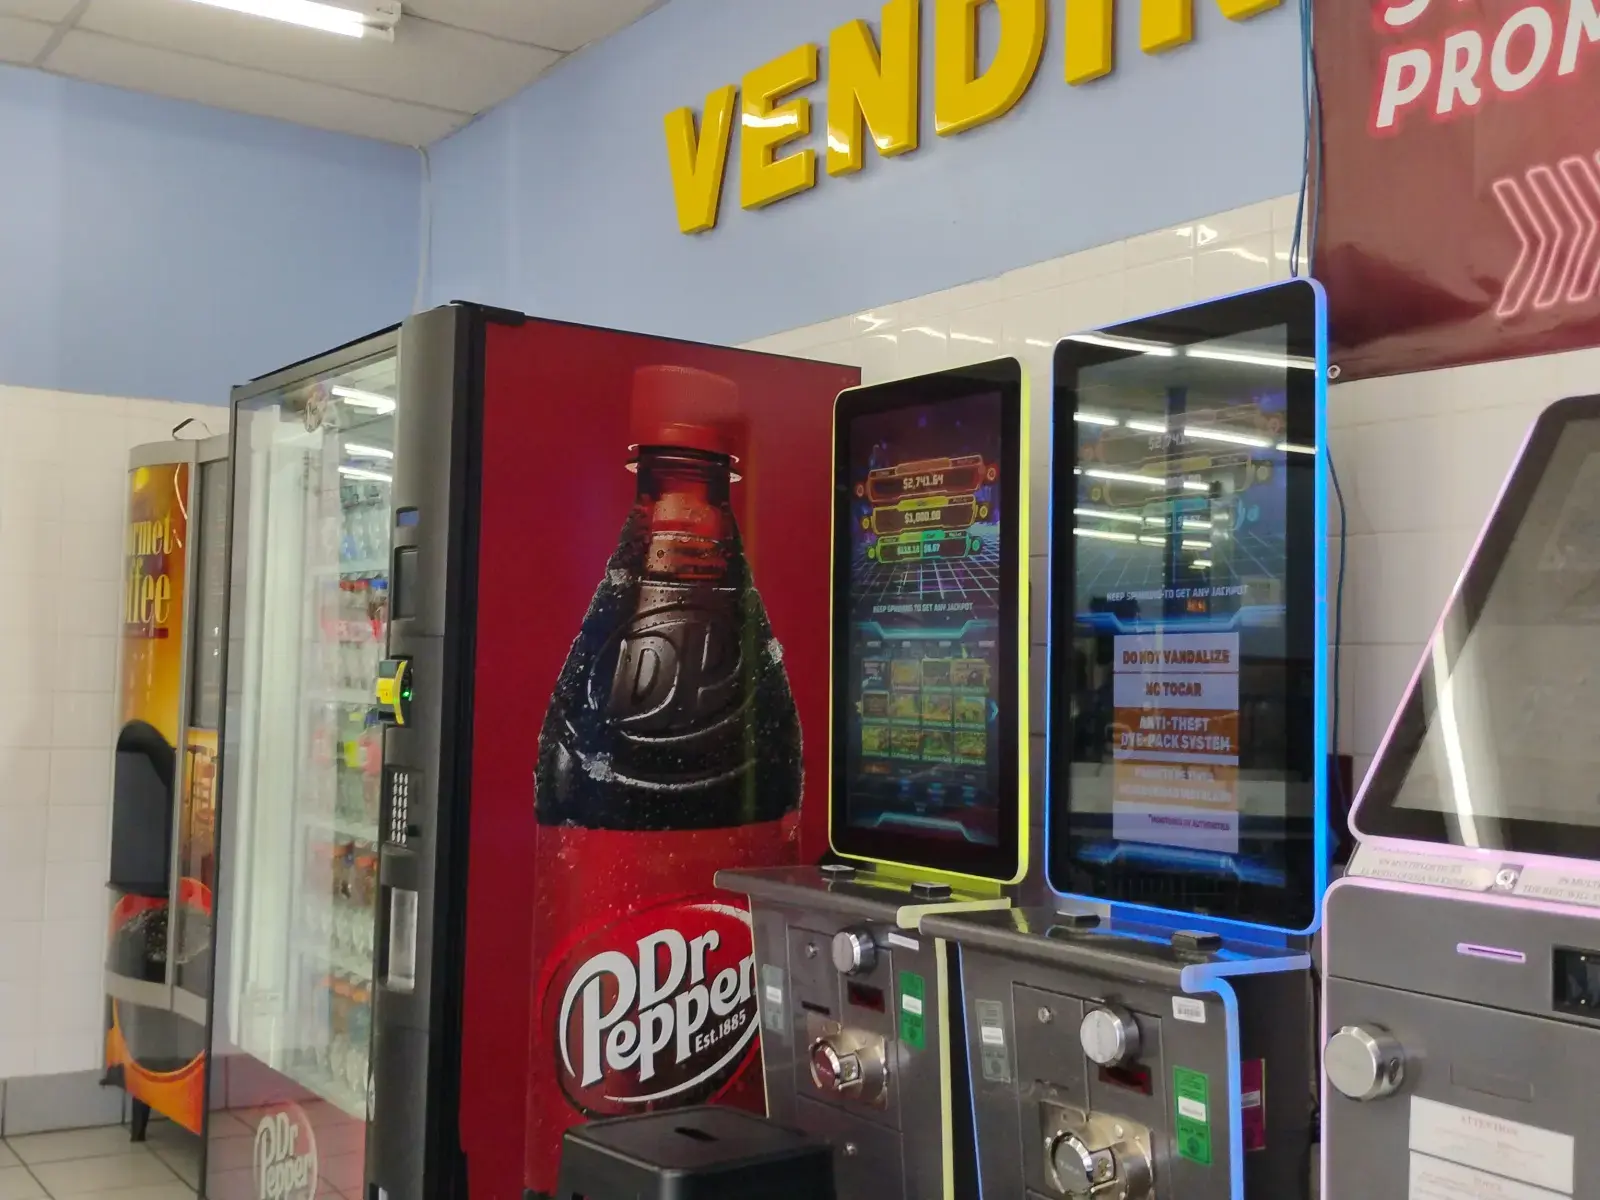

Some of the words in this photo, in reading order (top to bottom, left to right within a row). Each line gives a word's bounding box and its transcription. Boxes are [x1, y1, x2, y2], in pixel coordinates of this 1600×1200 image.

[1164, 589, 1174, 599] TO
[1176, 588, 1191, 598] GET
[1193, 587, 1210, 597] ANY
[921, 604, 933, 612] GET
[1123, 650, 1137, 664] DO
[1140, 650, 1160, 664] NOT
[1163, 649, 1230, 664] VANDALIZE
[1162, 682, 1202, 696] TOCAR
[1140, 716, 1210, 732] ANTI-THEFT
[1181, 734, 1230, 751] SYSTEM
[636, 929, 720, 1011] Dr
[559, 951, 756, 1088] Pepper
[276, 1112, 299, 1161] Dr
